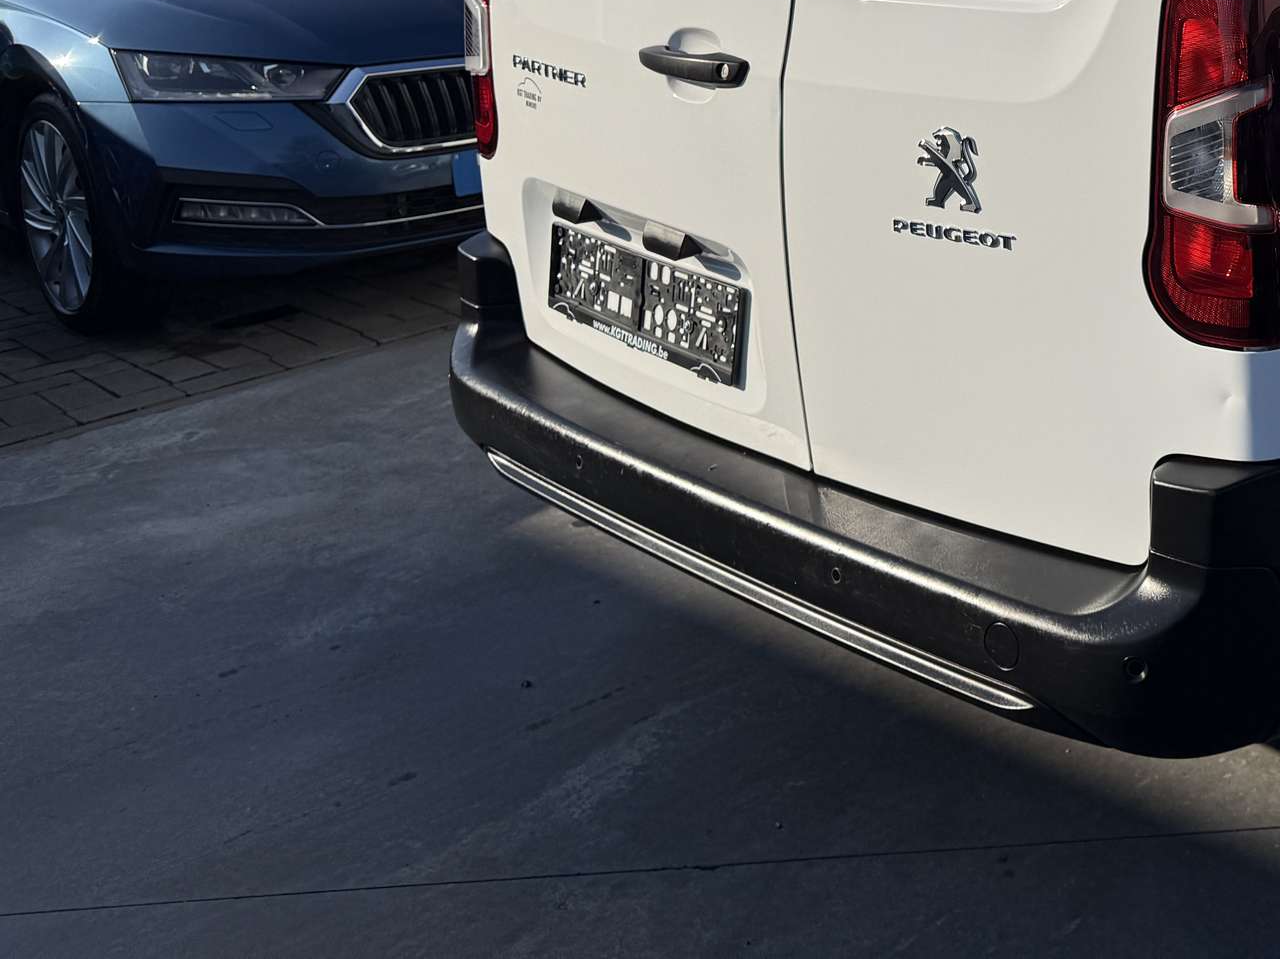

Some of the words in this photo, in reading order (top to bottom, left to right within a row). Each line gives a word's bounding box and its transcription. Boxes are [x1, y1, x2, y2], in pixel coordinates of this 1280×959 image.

[512, 54, 587, 88] PARTNER
[893, 219, 1017, 251] PEUGEOT
[592, 319, 669, 360] www.KGTTRADING.be
